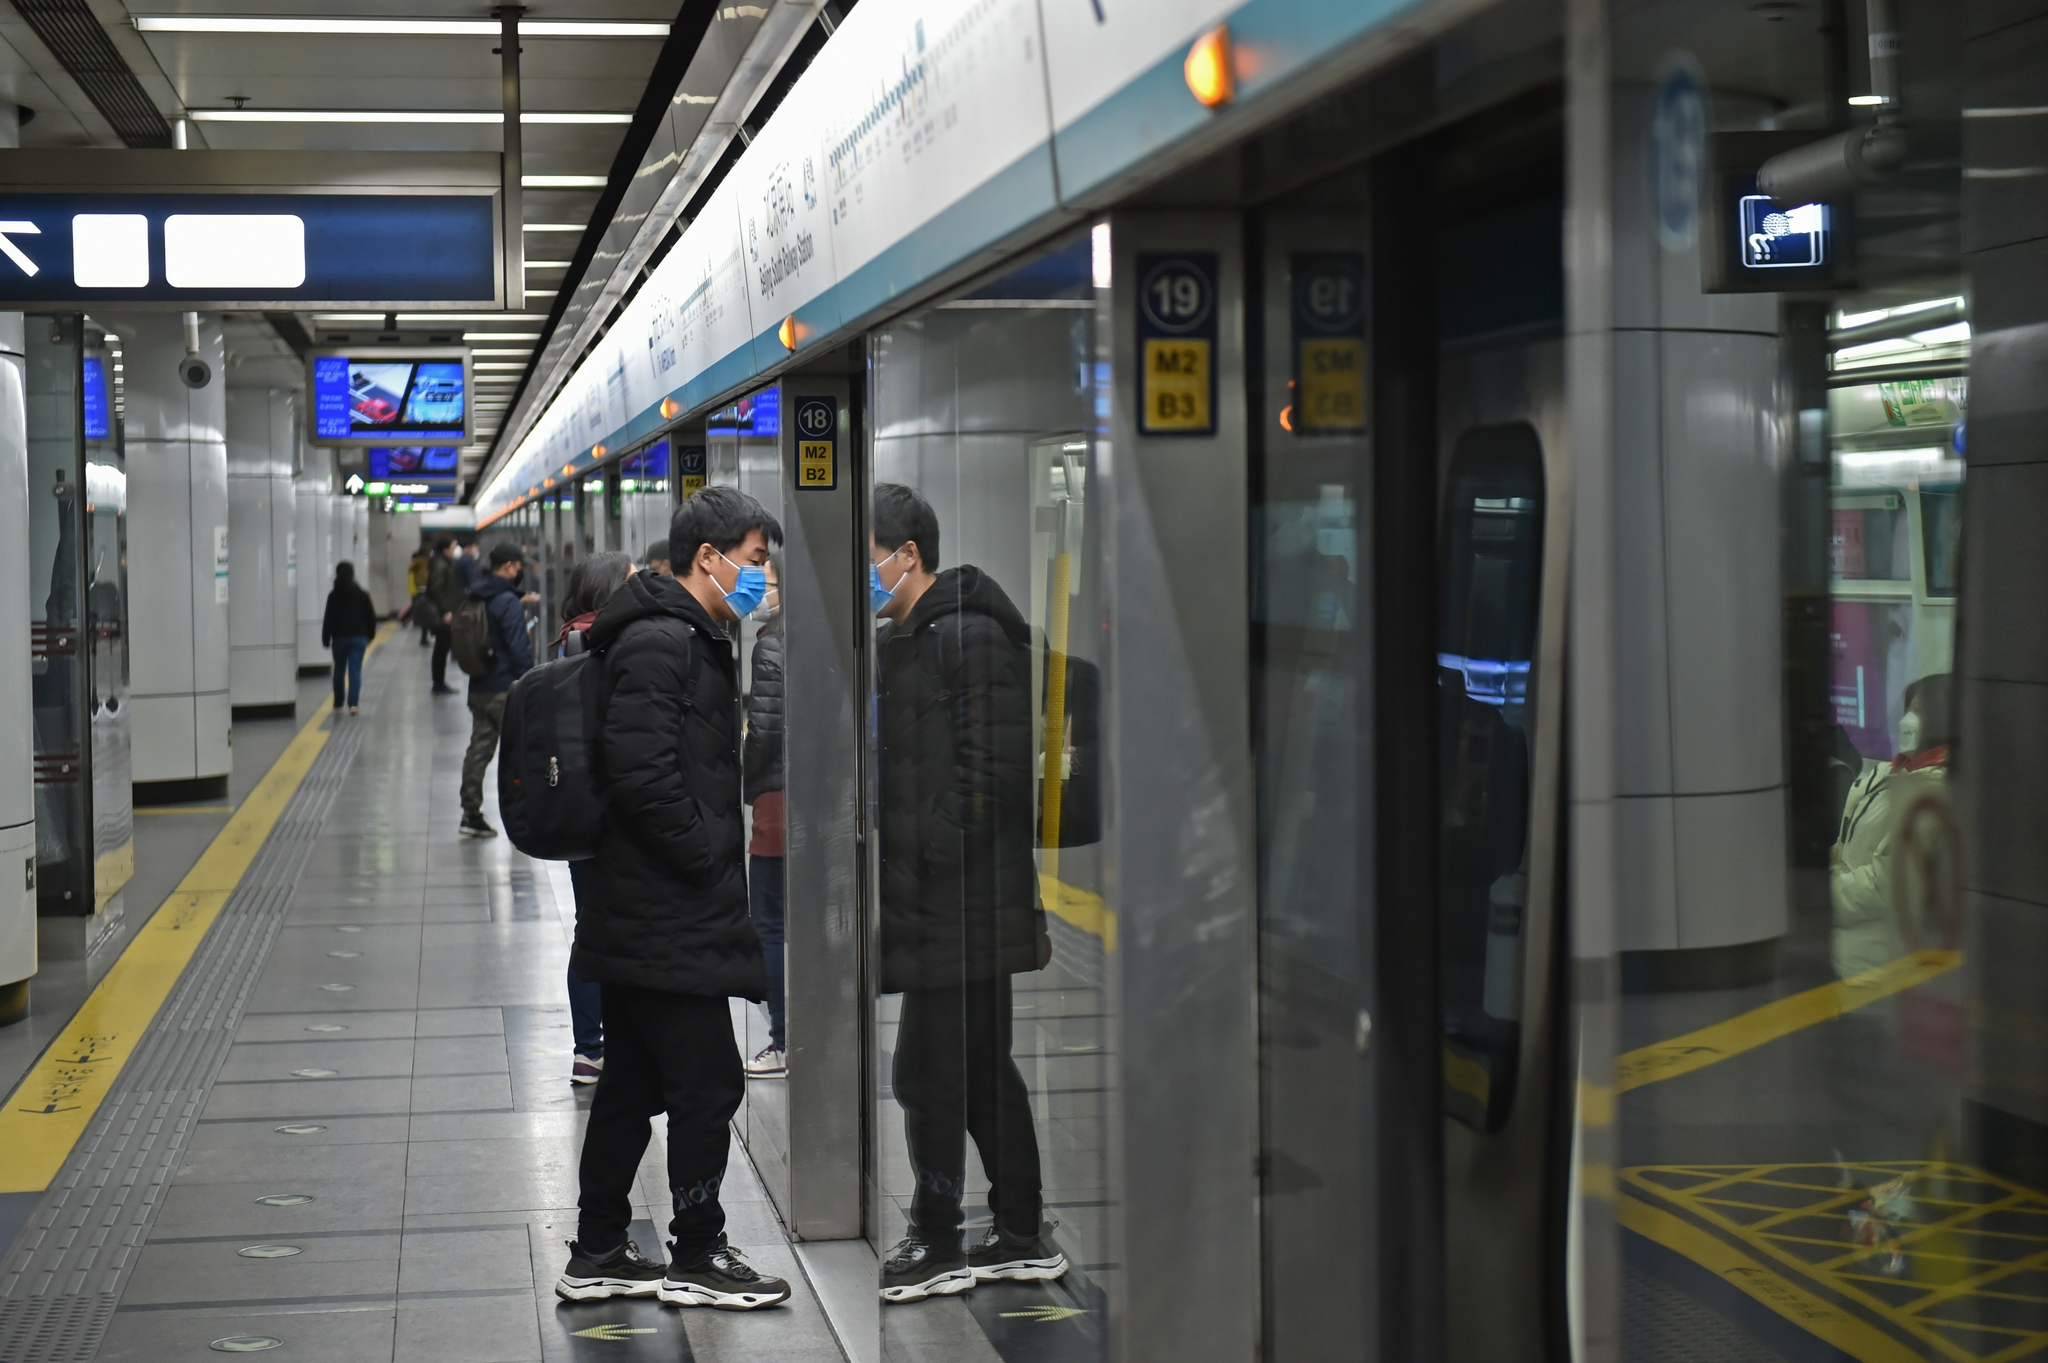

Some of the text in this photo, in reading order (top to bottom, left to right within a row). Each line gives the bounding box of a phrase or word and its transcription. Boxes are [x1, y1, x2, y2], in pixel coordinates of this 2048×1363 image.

[759, 263, 775, 301] Beijing
[771, 251, 785, 287] South
[782, 243, 800, 278] Railway
[797, 228, 815, 267] Station
[1151, 275, 1200, 317] 19
[1155, 350, 1199, 375] M2
[1157, 392, 1196, 419] B3
[803, 409, 827, 429] 18
[684, 454, 700, 467] 17
[805, 446, 827, 459] M2
[686, 478, 701, 487] M2
[806, 468, 826, 480] B2
